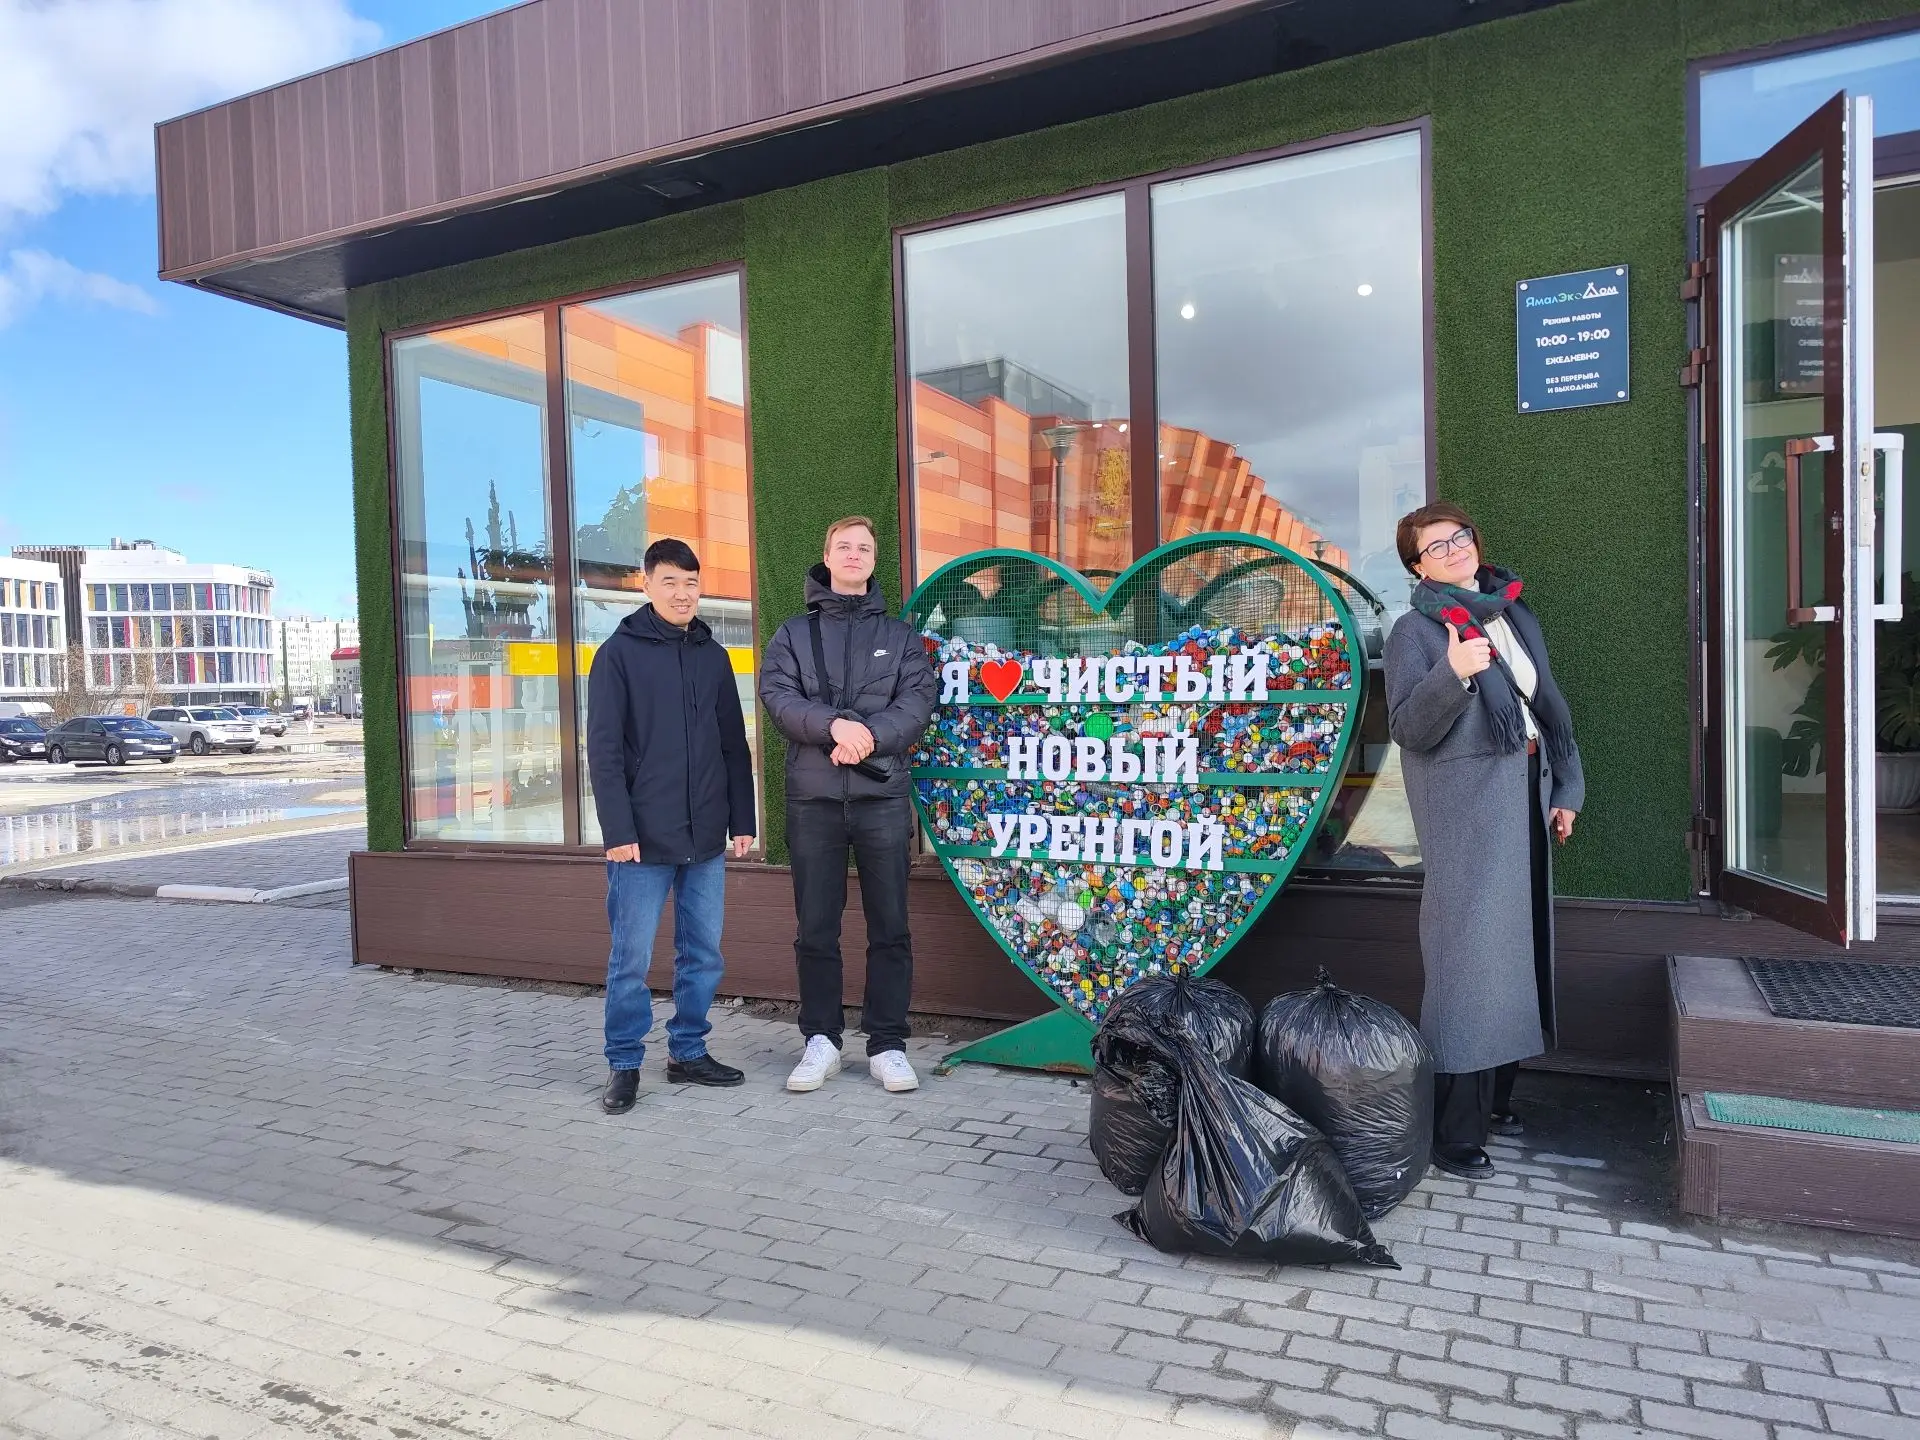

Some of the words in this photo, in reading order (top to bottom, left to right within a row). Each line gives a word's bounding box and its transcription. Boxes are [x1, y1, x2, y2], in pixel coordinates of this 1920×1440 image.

[1535, 334, 1568, 348] 10:00
[1577, 328, 1610, 343] 19:00
[1545, 351, 1600, 366] ЕЖЕДНЕВНО
[1545, 376, 1560, 385] БЕЗ
[1560, 371, 1600, 383] ПЕРЕРЫВА
[1547, 386, 1554, 394] И
[1554, 382, 1599, 393] ВЫХОДНЫХ
[940, 660, 971, 704] Я
[1031, 643, 1270, 704] ЧИСТЫЙ
[1006, 723, 1200, 784] НОВЫЙ
[987, 813, 1225, 871] УРЕНГОЙ
